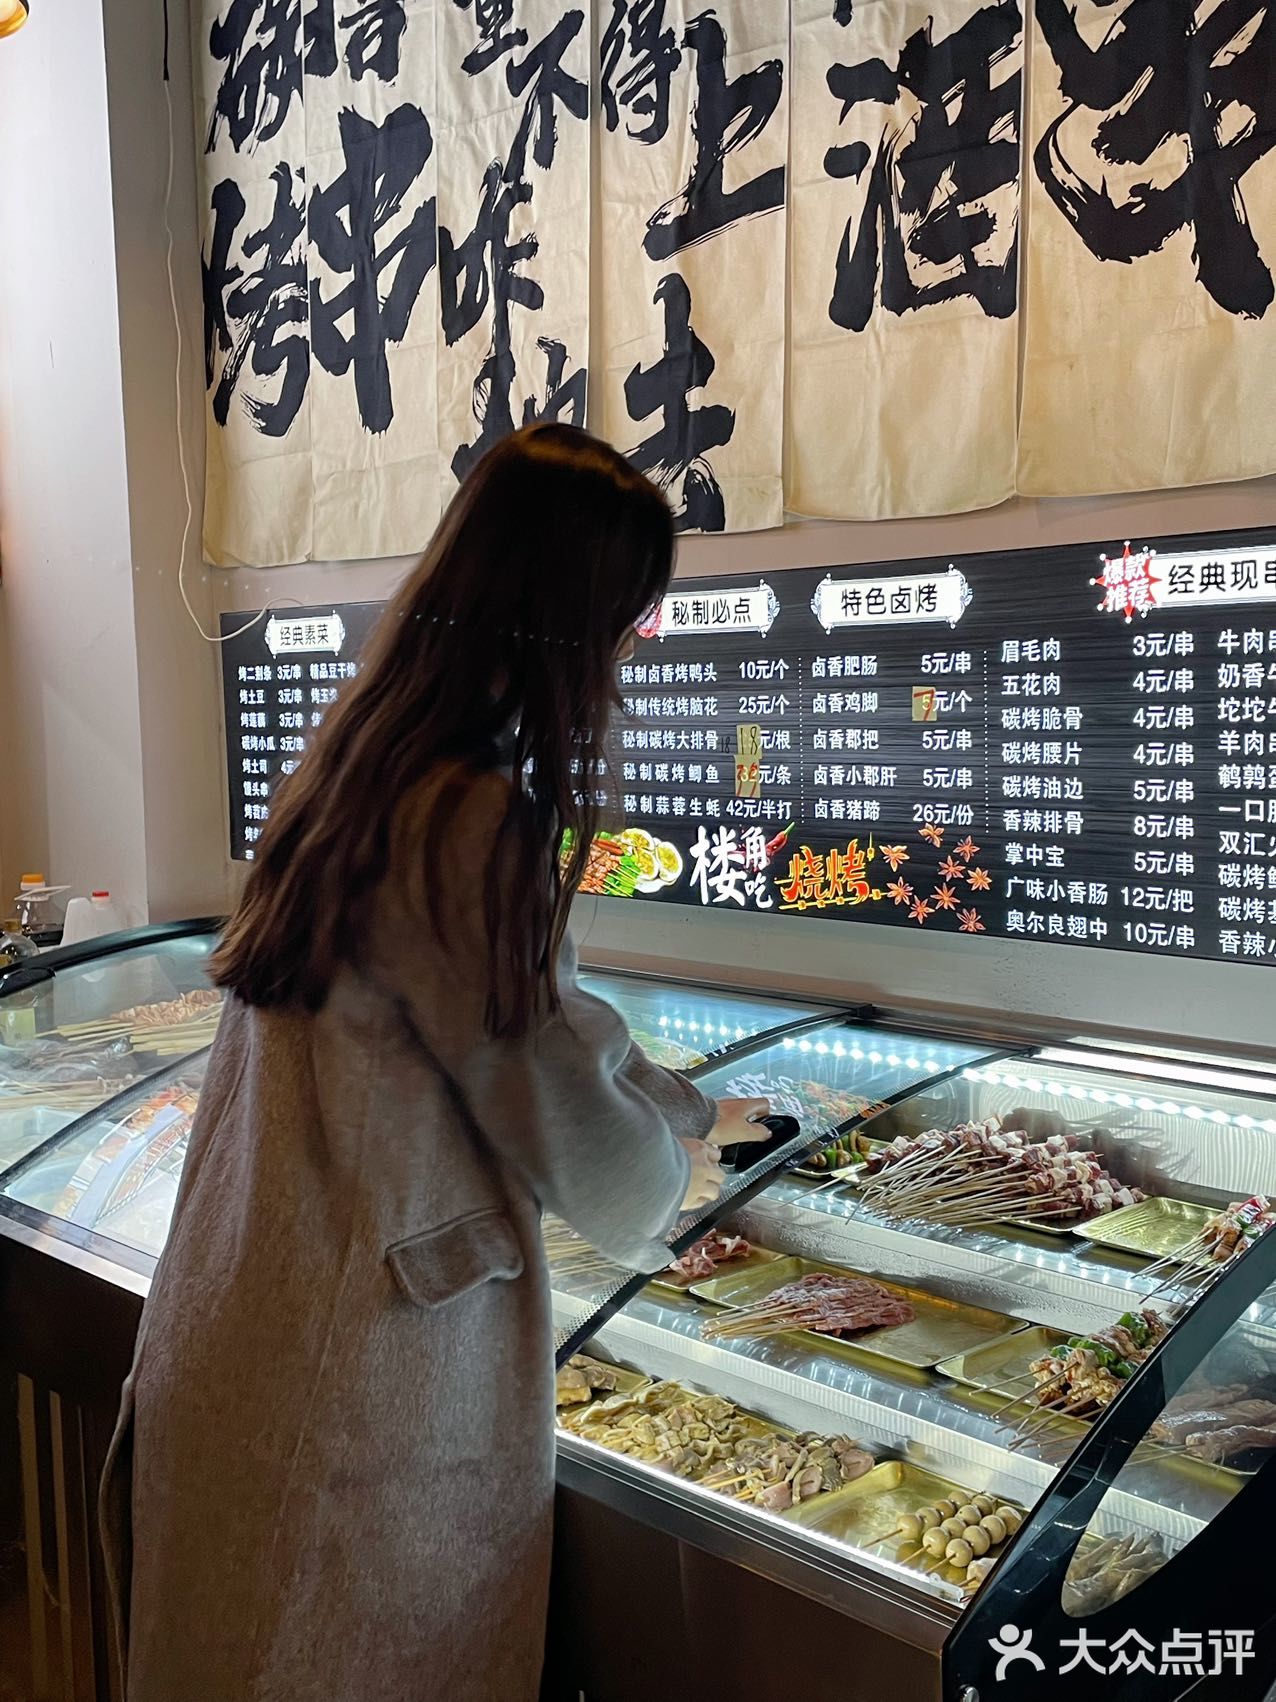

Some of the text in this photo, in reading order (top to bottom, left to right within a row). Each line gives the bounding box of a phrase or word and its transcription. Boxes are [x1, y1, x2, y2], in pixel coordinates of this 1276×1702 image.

[671, 596, 752, 627] 秘制必点
[841, 583, 938, 617] 特色卤烤
[280, 624, 329, 646] 经典素菜
[1001, 630, 1194, 663] 眉毛肉 3元/串
[277, 664, 302, 680] 3元/串
[620, 658, 790, 683] 秘制卤香烤鸭头 10元/个
[811, 651, 972, 678] 卤香肥肠 5元/串
[1001, 668, 1194, 696] 五花肉 4元/串
[240, 688, 303, 704] 烤土豆 3元/串
[623, 694, 790, 717] 秘制传统烤脑花 25元/个
[812, 692, 878, 714] 卤香鸡脚
[279, 712, 304, 728] 3元/串
[1001, 704, 1194, 731] 碳烤脆骨 4元/串
[280, 736, 304, 752] 3元/串
[622, 729, 719, 751] 秘制碳烤大排骨
[813, 728, 973, 751] 卤香郡把 5元/串
[1002, 741, 1194, 767] 碳烤腰片 4元/串
[623, 762, 720, 784] 秘制碳烤鲫鱼
[813, 764, 973, 790] 卤香小郡肝 5元/串
[1002, 776, 1195, 803] 碳烤油边 5元/串
[623, 794, 720, 817] 秘制蒜蓉生蚝
[726, 799, 792, 820] 42元/半打
[814, 798, 974, 826] 卤香猪蹄 26元/份
[1003, 810, 1195, 840] 香辣排骨 8元/串
[1005, 842, 1195, 876] 掌中宝 5元/串
[778, 839, 870, 906] 烧烤
[1006, 876, 1194, 913] 广味小香肠 12元/把
[1006, 909, 1195, 949] 奥尔良翅中 10元/串
